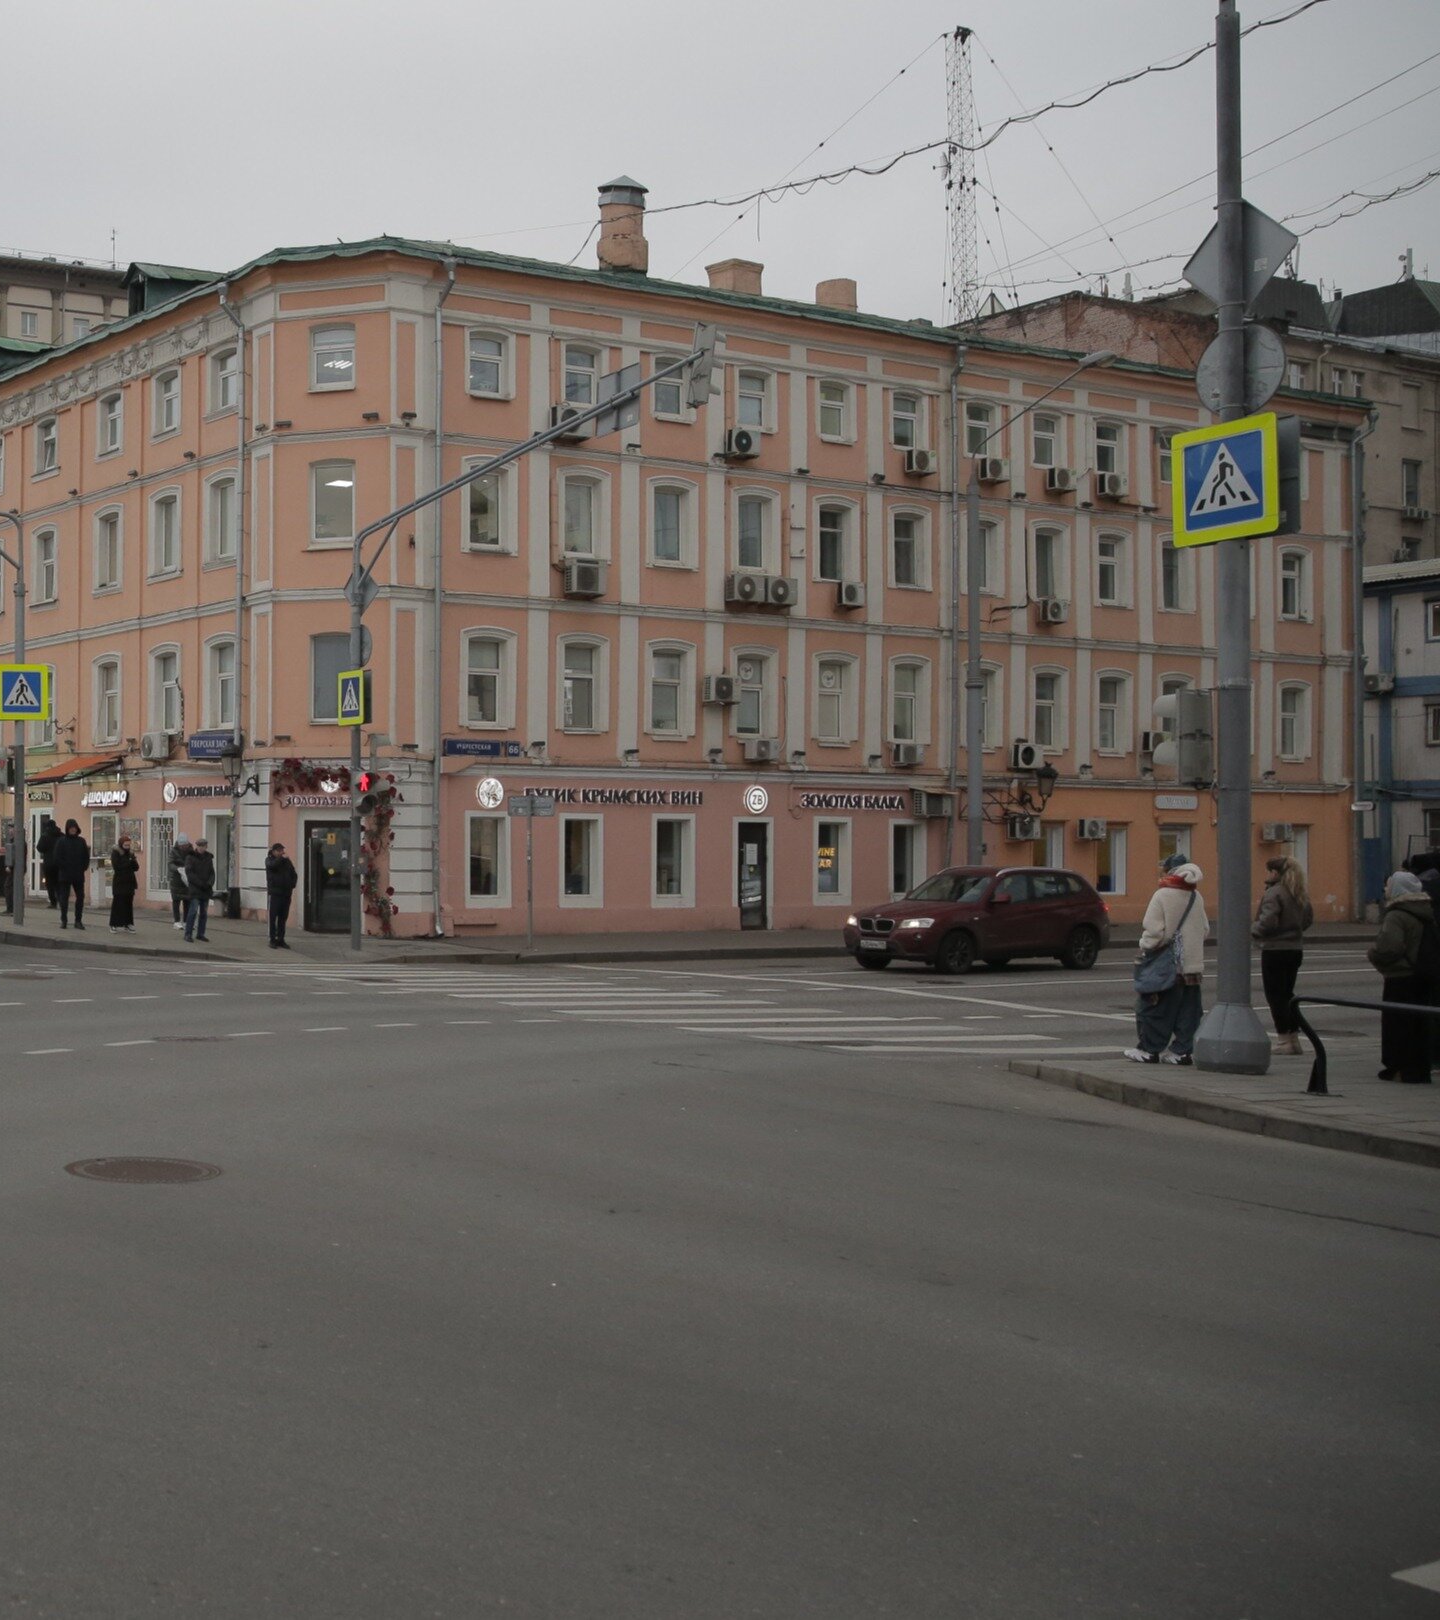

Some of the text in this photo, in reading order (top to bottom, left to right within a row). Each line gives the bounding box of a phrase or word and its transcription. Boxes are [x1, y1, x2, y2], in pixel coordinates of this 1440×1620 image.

[508, 744, 519, 754] 66
[285, 794, 338, 807] ЗОЛОТАЯ
[580, 787, 668, 806] КРЫМСКИХ
[669, 789, 704, 806] ВИН
[800, 792, 905, 811] ЗОЛОТАЯ БАЛКА
